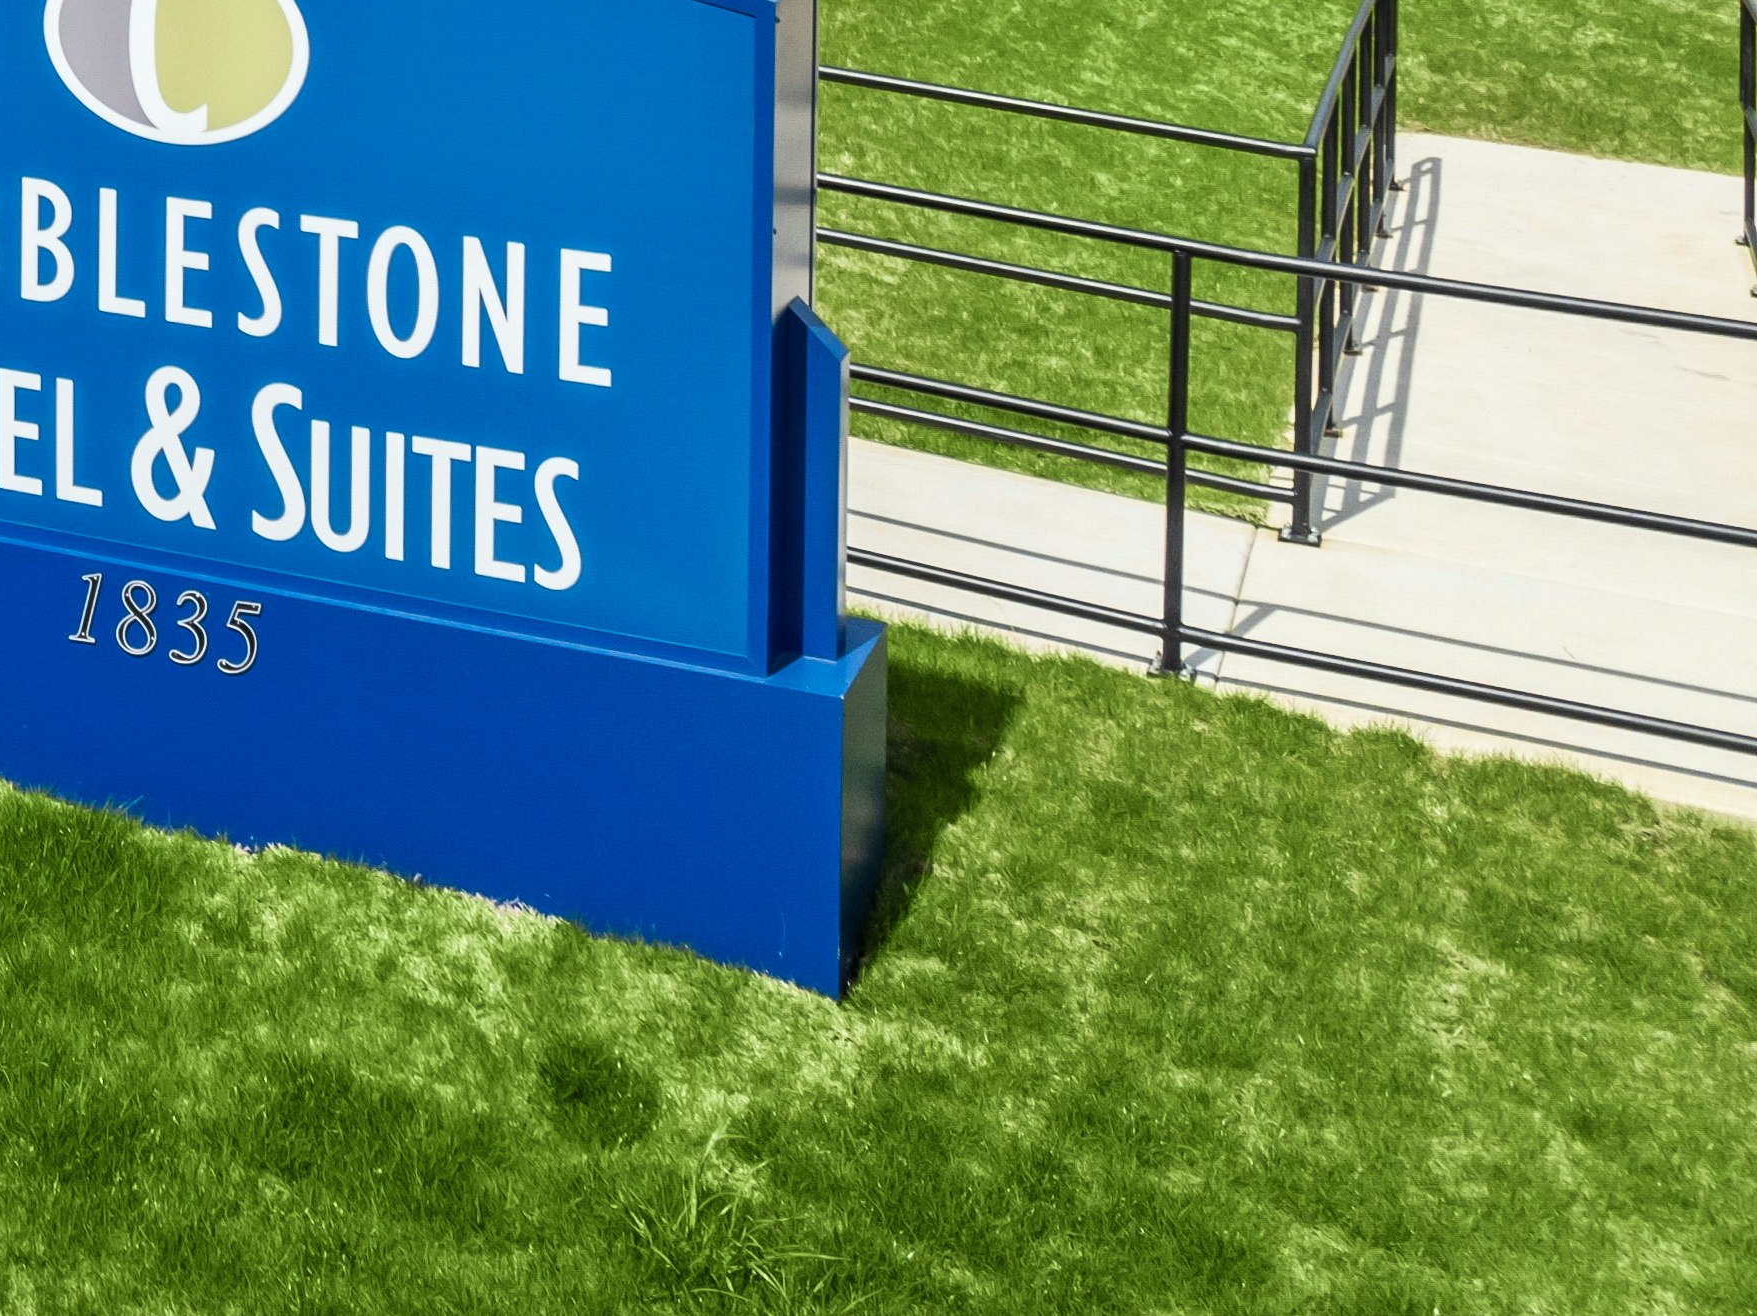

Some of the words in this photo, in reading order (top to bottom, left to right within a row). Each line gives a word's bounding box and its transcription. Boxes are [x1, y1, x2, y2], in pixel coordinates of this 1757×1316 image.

[131, 366, 216, 530] &
[251, 383, 581, 590] SUITES
[68, 572, 262, 674] 1835
